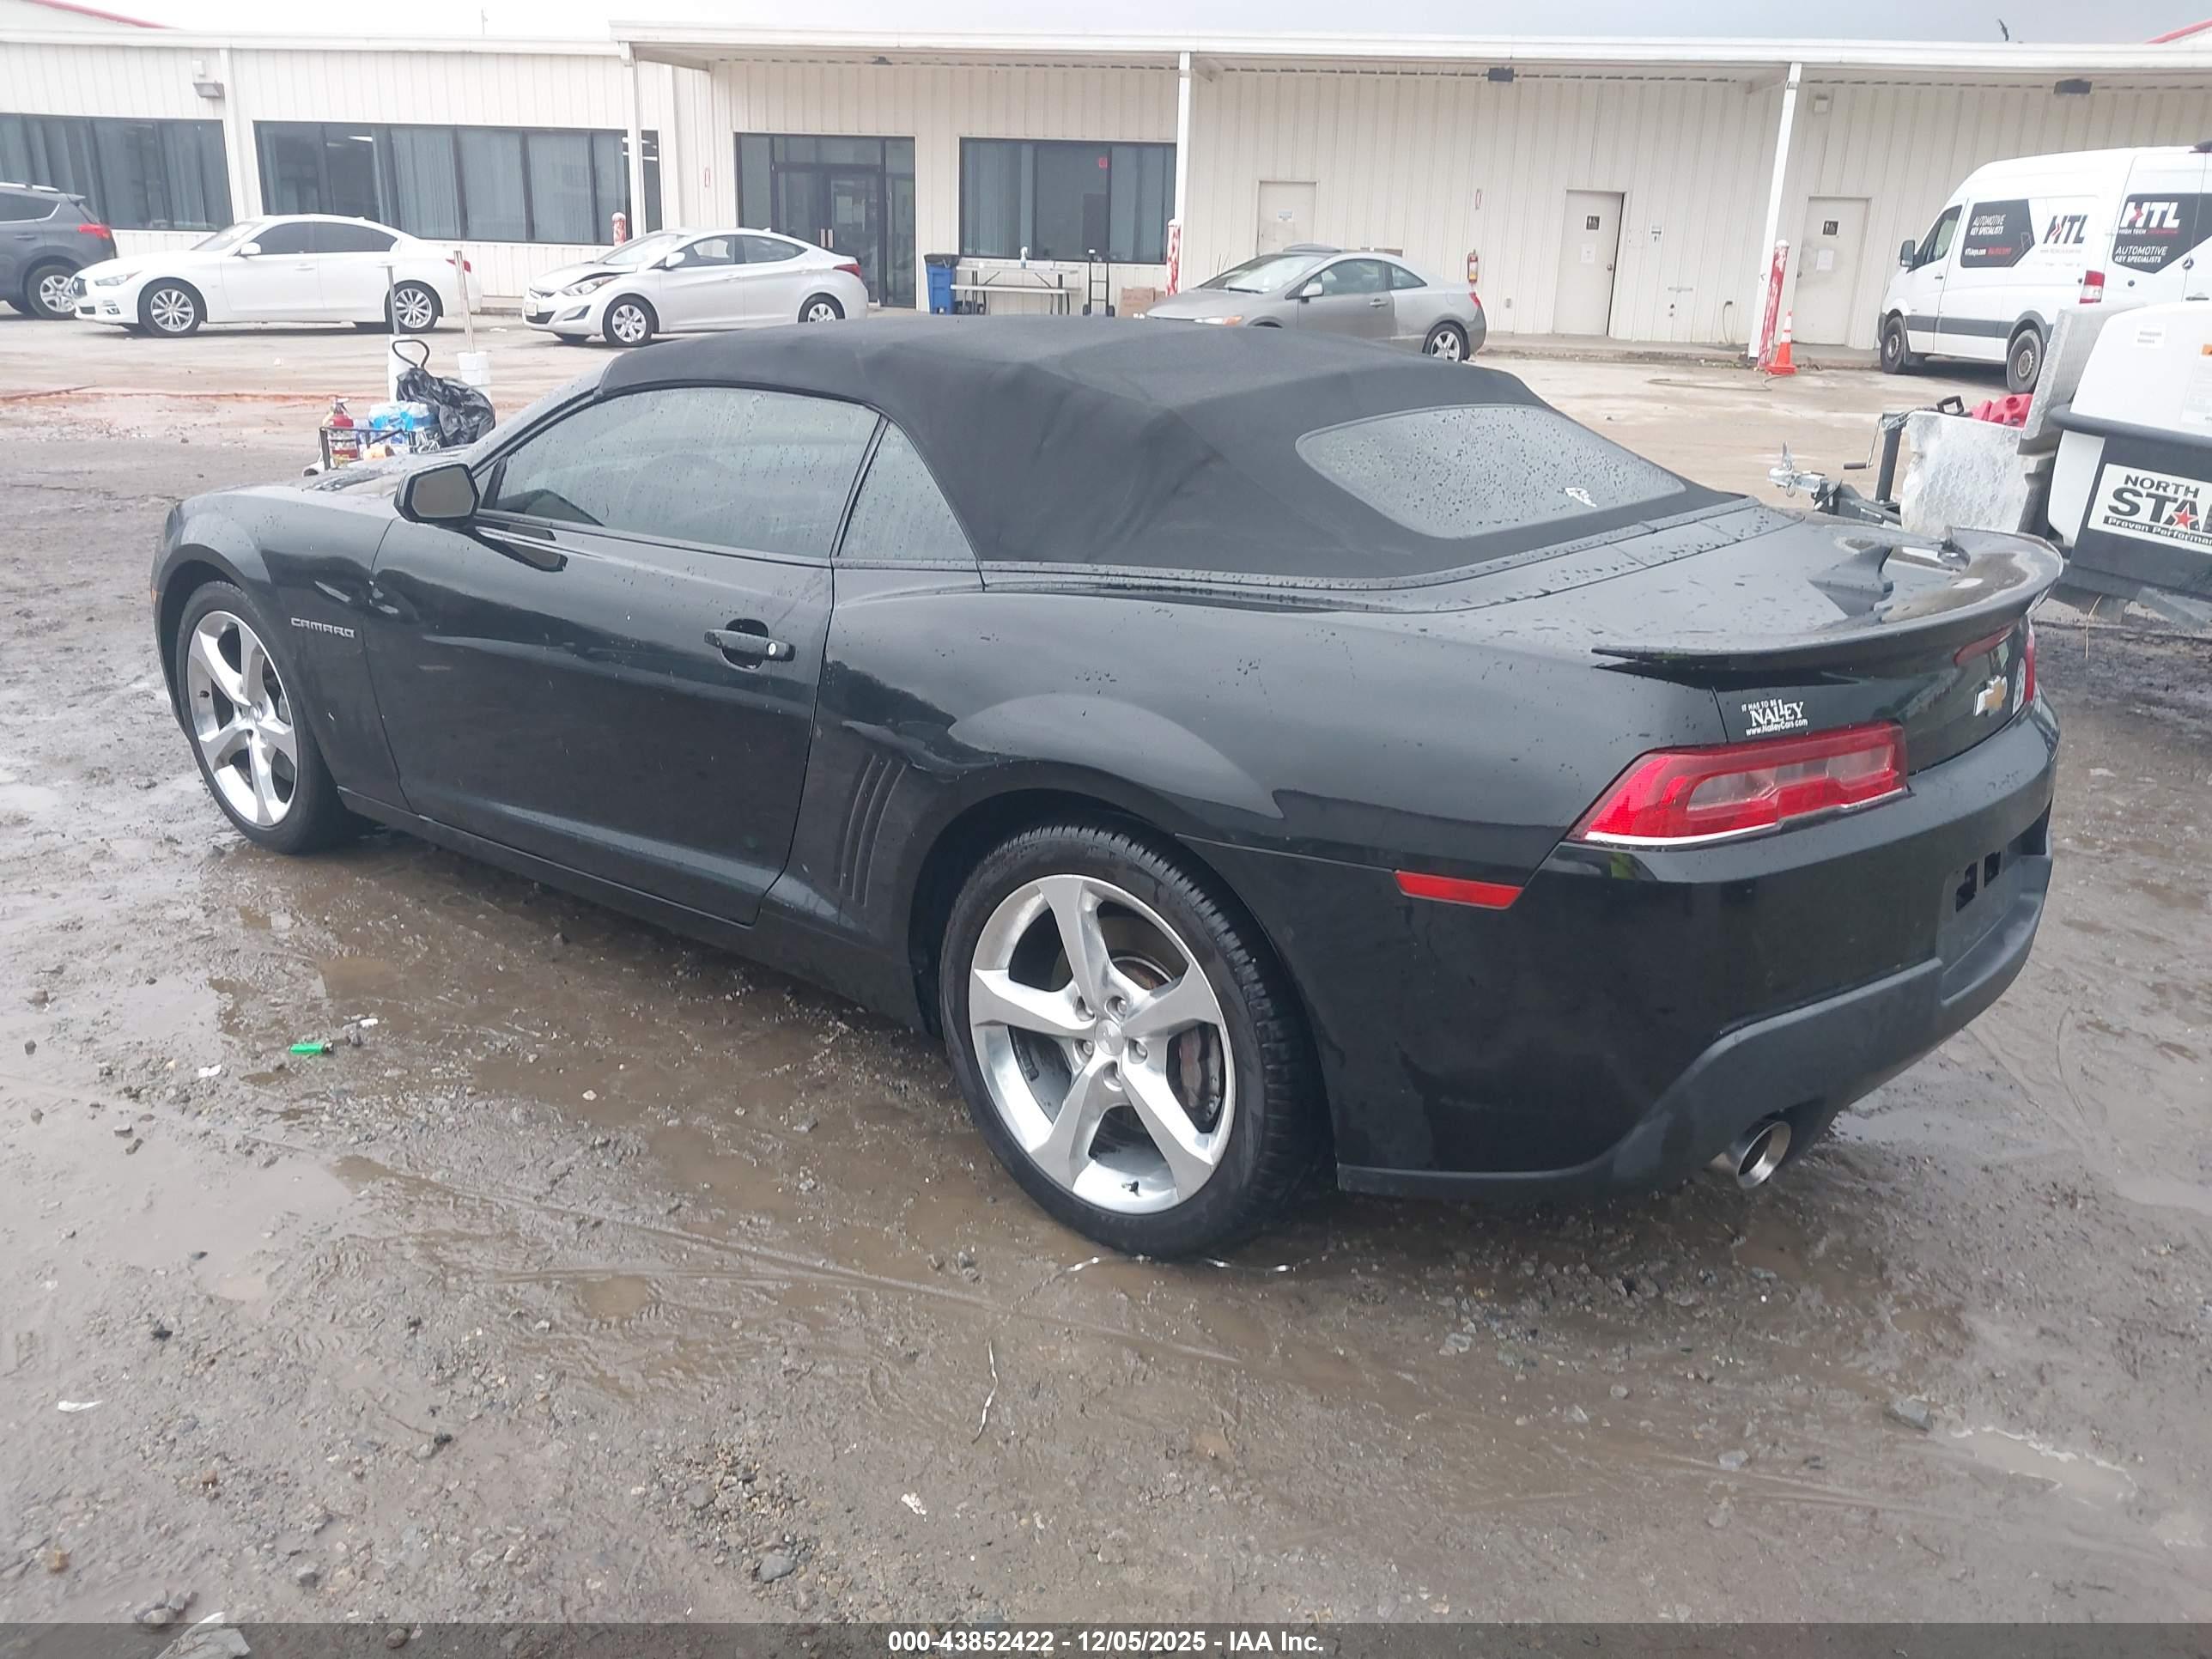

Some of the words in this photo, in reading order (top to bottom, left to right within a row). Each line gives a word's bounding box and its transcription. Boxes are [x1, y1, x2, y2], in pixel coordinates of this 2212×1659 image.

[1972, 214, 2007, 227] AUTOMOTIVE
[2119, 202, 2181, 228] HTL
[2043, 215, 2088, 244] HTL
[2115, 246, 2169, 256] AUTOMOTIVE
[2124, 474, 2200, 499] NORTH
[2108, 517, 2148, 532] Proven
[290, 617, 355, 638] CAMARO
